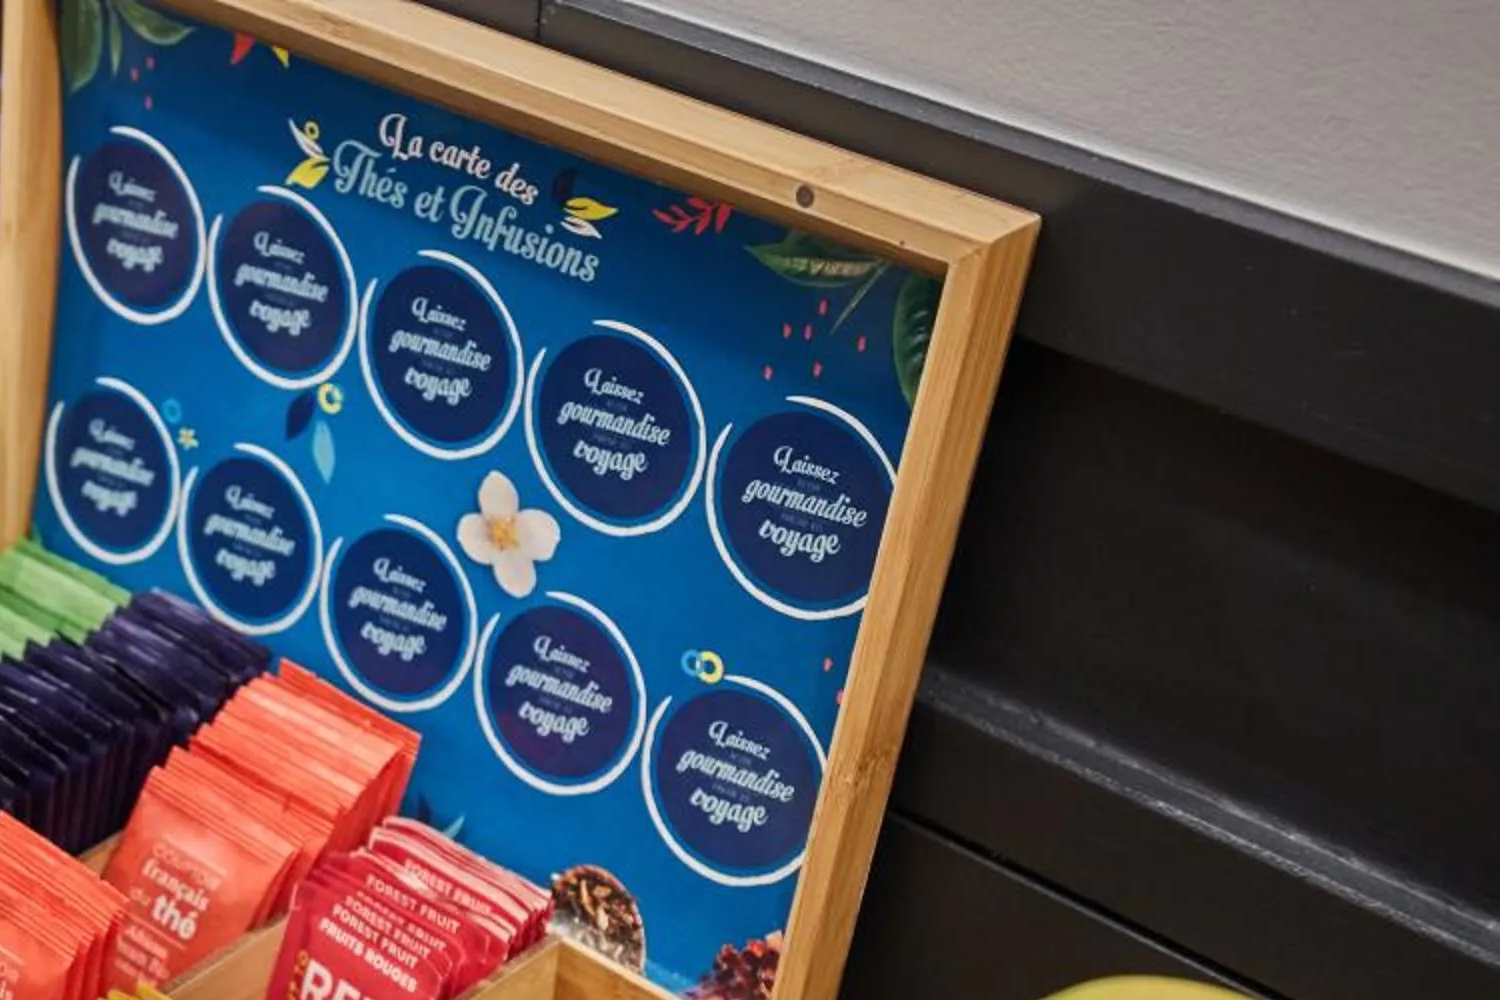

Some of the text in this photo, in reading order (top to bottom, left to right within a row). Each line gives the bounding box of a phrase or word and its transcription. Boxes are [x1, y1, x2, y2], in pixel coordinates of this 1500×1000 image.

[379, 112, 539, 207] La carte des
[333, 139, 600, 283] Thés et Infusions
[583, 367, 644, 405] Laissez
[556, 400, 671, 447] gourmandise
[573, 439, 648, 481] voyage
[773, 445, 841, 485] Laissez
[741, 479, 868, 528] gourmandise
[758, 519, 842, 563] voyage
[533, 635, 591, 673] Laissez
[505, 664, 613, 714] gourmandise
[518, 701, 590, 744] voyage
[708, 721, 772, 760] Laissez
[676, 750, 795, 803] gourmandise
[690, 787, 768, 833] voyage
[142, 857, 209, 911] français
[366, 875, 417, 911] FOREST
[419, 900, 460, 934] FRUIT
[153, 894, 198, 940] thé
[332, 903, 380, 942] FOREST
[380, 933, 419, 969] FRUIT
[345, 895, 394, 932] FOREST
[393, 924, 431, 958] FRUIT
[319, 917, 419, 992] FRUITS ROUGES
